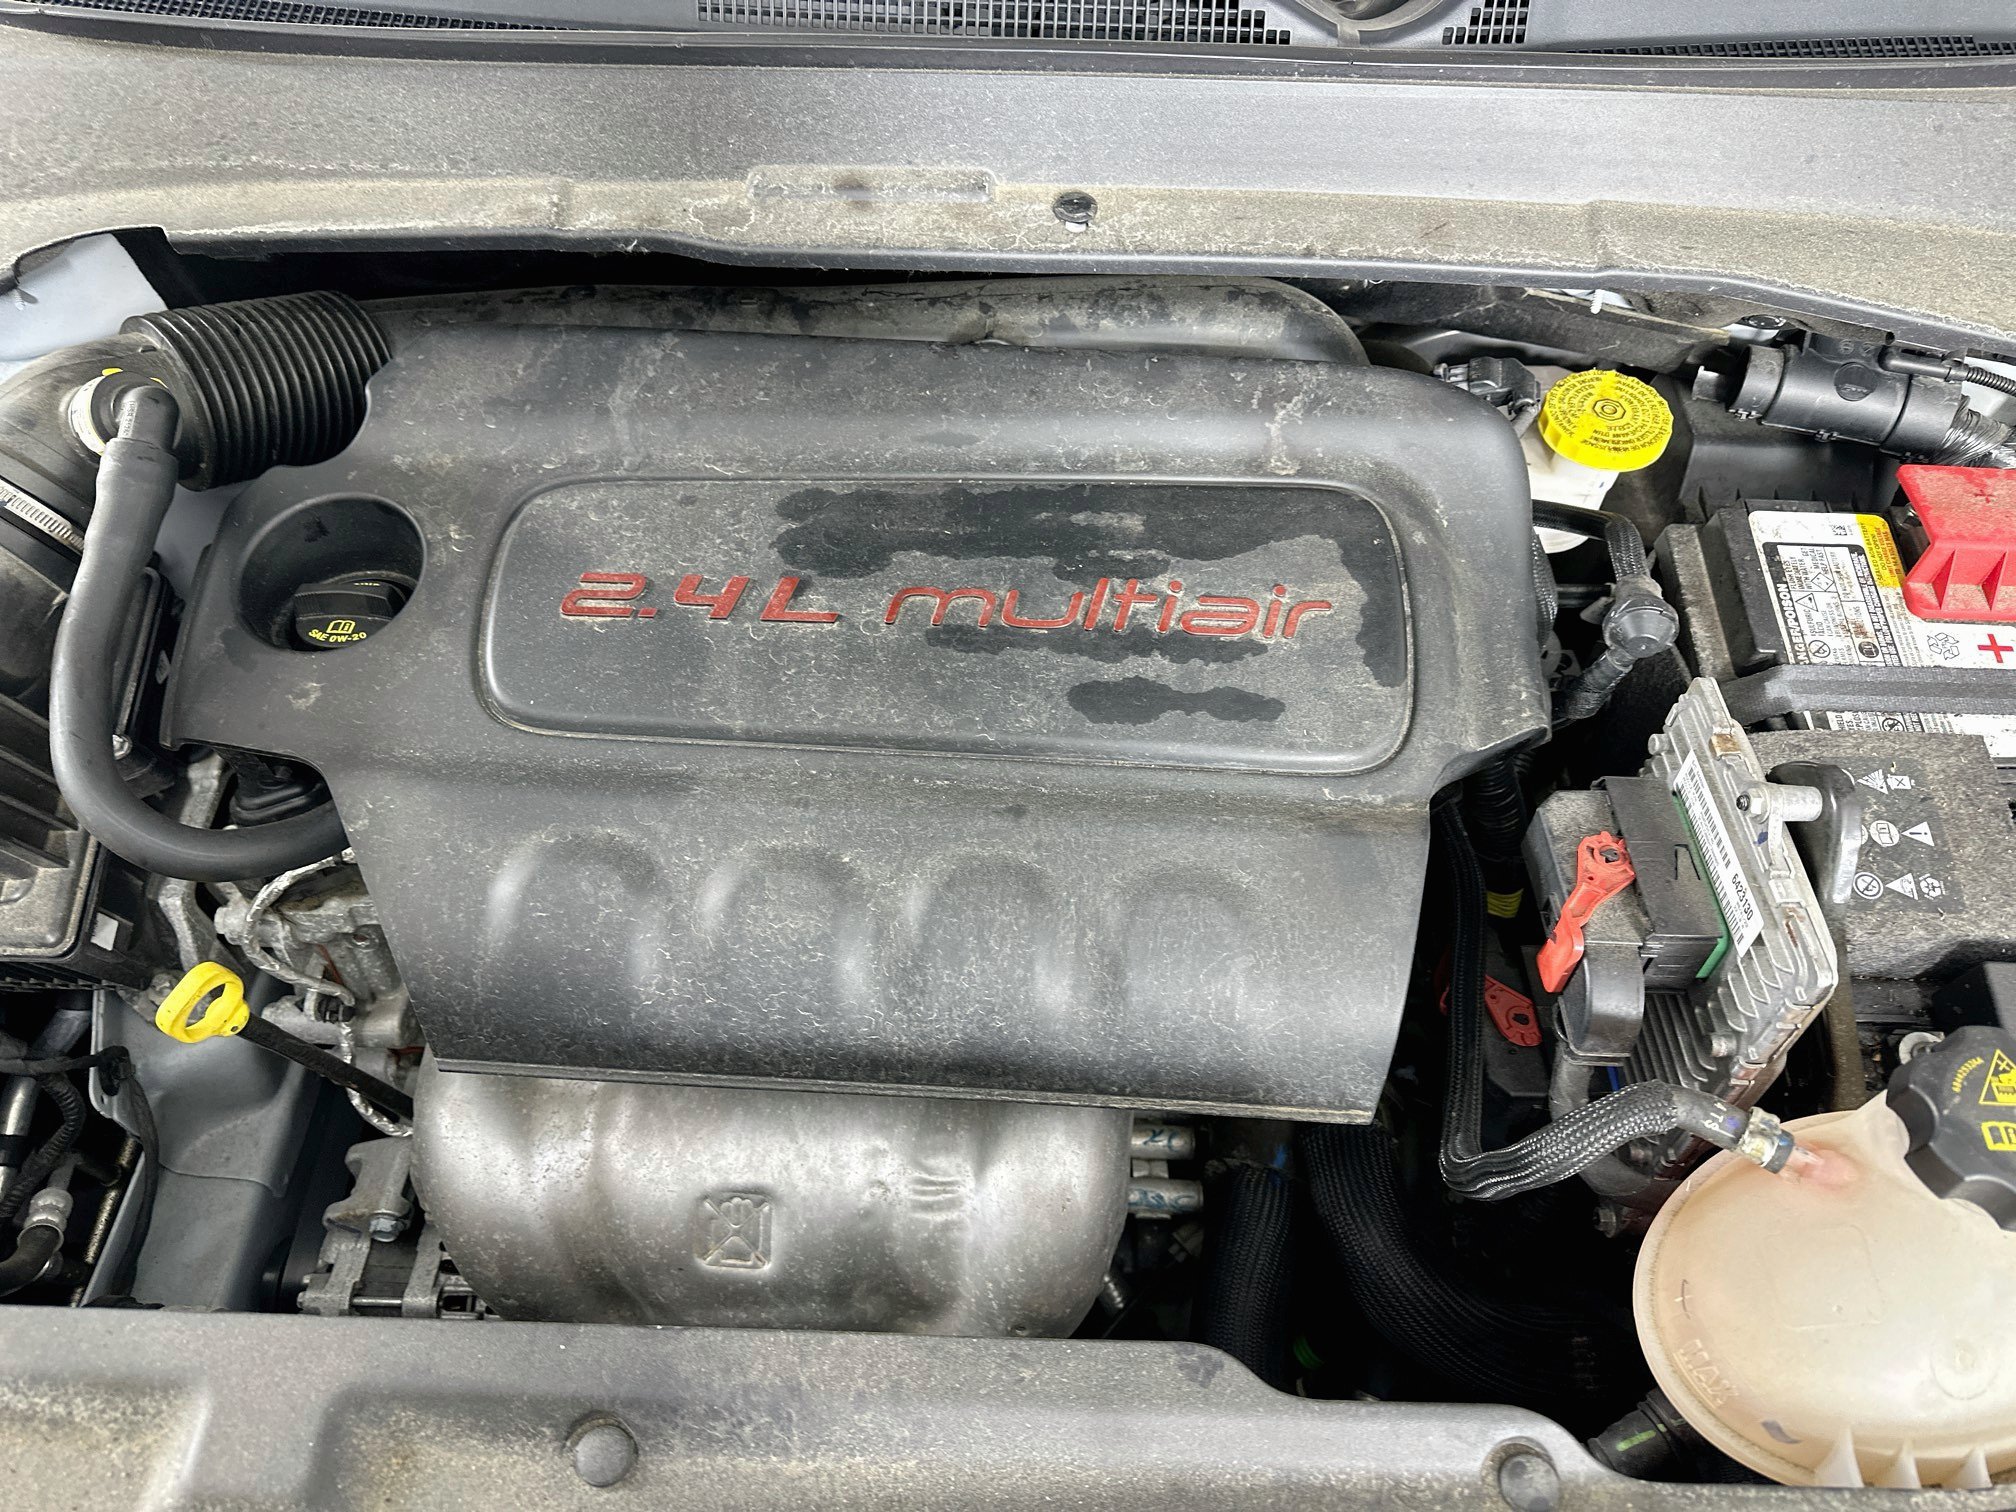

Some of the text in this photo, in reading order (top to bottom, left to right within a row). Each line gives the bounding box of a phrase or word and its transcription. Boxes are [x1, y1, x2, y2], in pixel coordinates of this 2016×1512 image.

[308, 628, 368, 644] SAE 0W-20
[883, 576, 1336, 642] multiair
[1775, 583, 1811, 664] ANGER/POISON
[1731, 873, 1754, 921] 6423130
[1679, 1337, 1741, 1405] MAX
